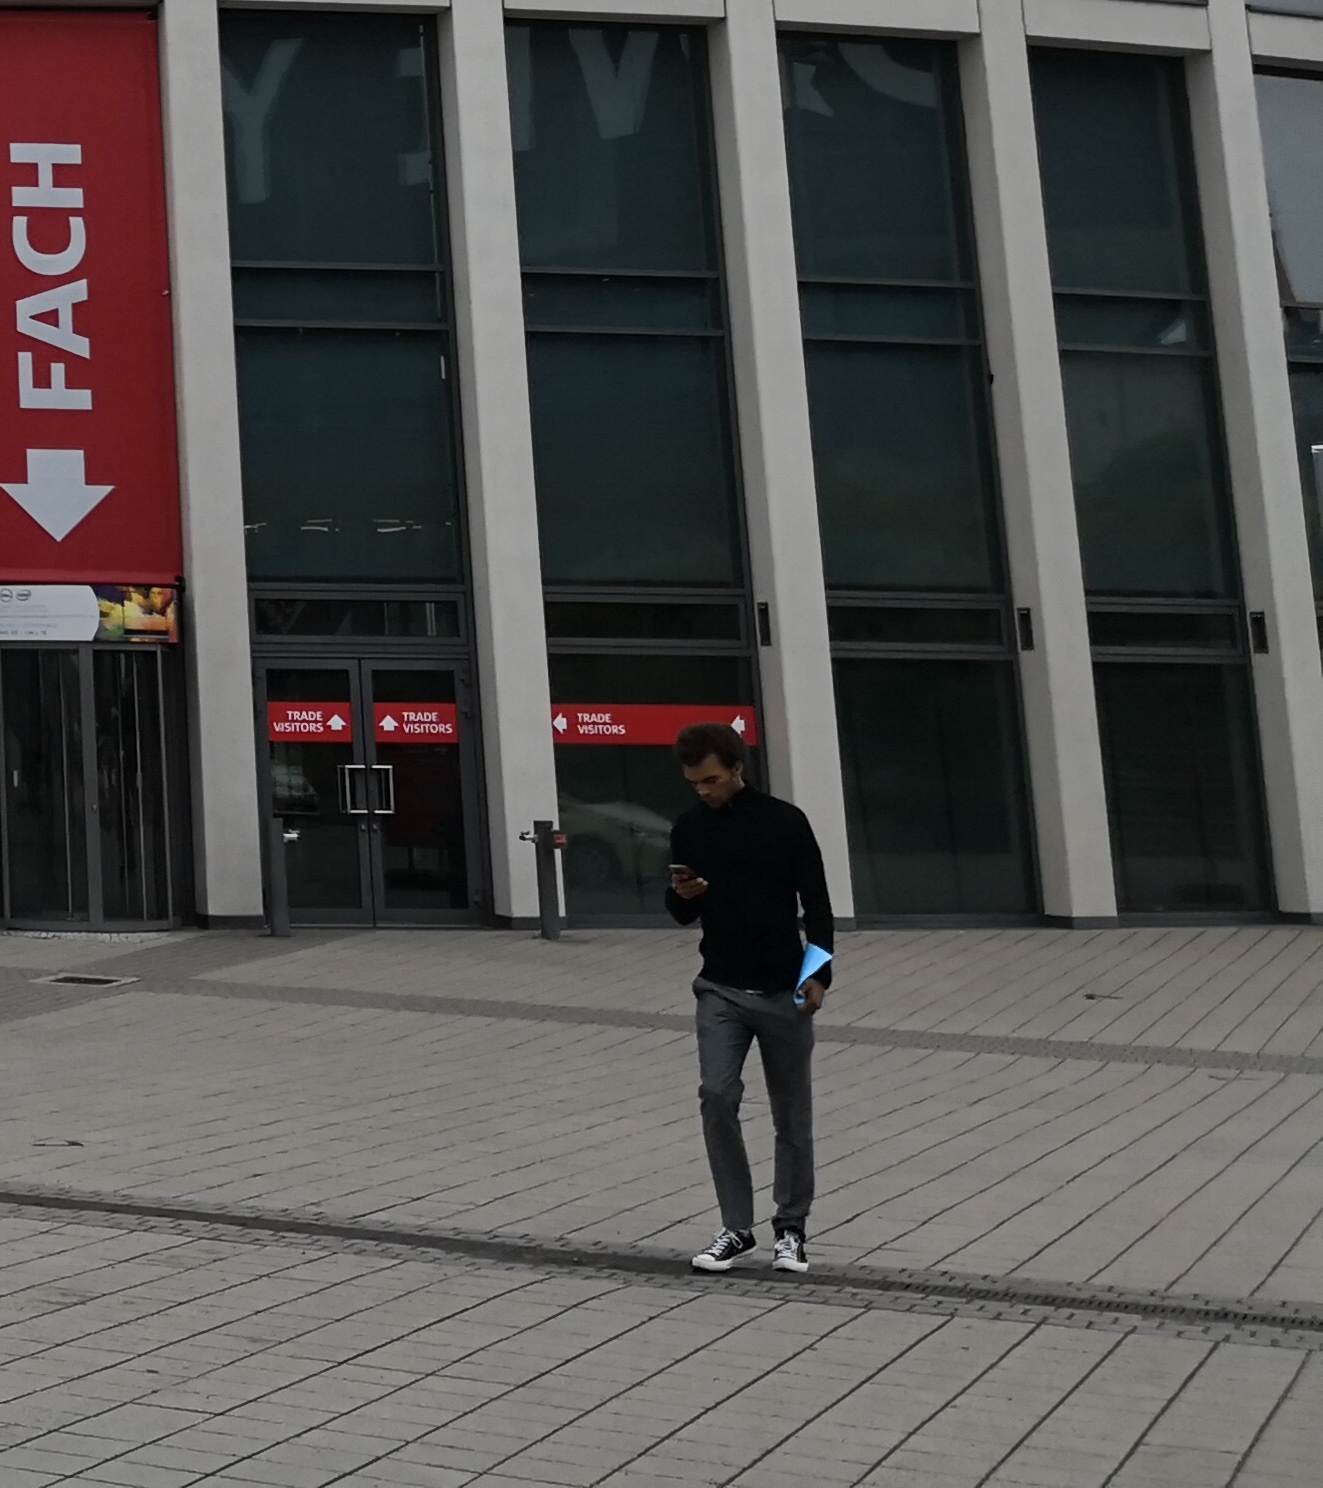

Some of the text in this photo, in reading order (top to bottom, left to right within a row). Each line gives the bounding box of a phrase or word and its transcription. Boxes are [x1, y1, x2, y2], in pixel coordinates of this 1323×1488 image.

[9, 142, 93, 411] FACH
[286, 710, 324, 721] TRADE
[402, 712, 439, 723] TRADE
[576, 712, 613, 724] TRADE
[273, 722, 324, 733] VISITORS
[402, 723, 453, 734] VISITORS
[576, 724, 626, 735] VISITORS
